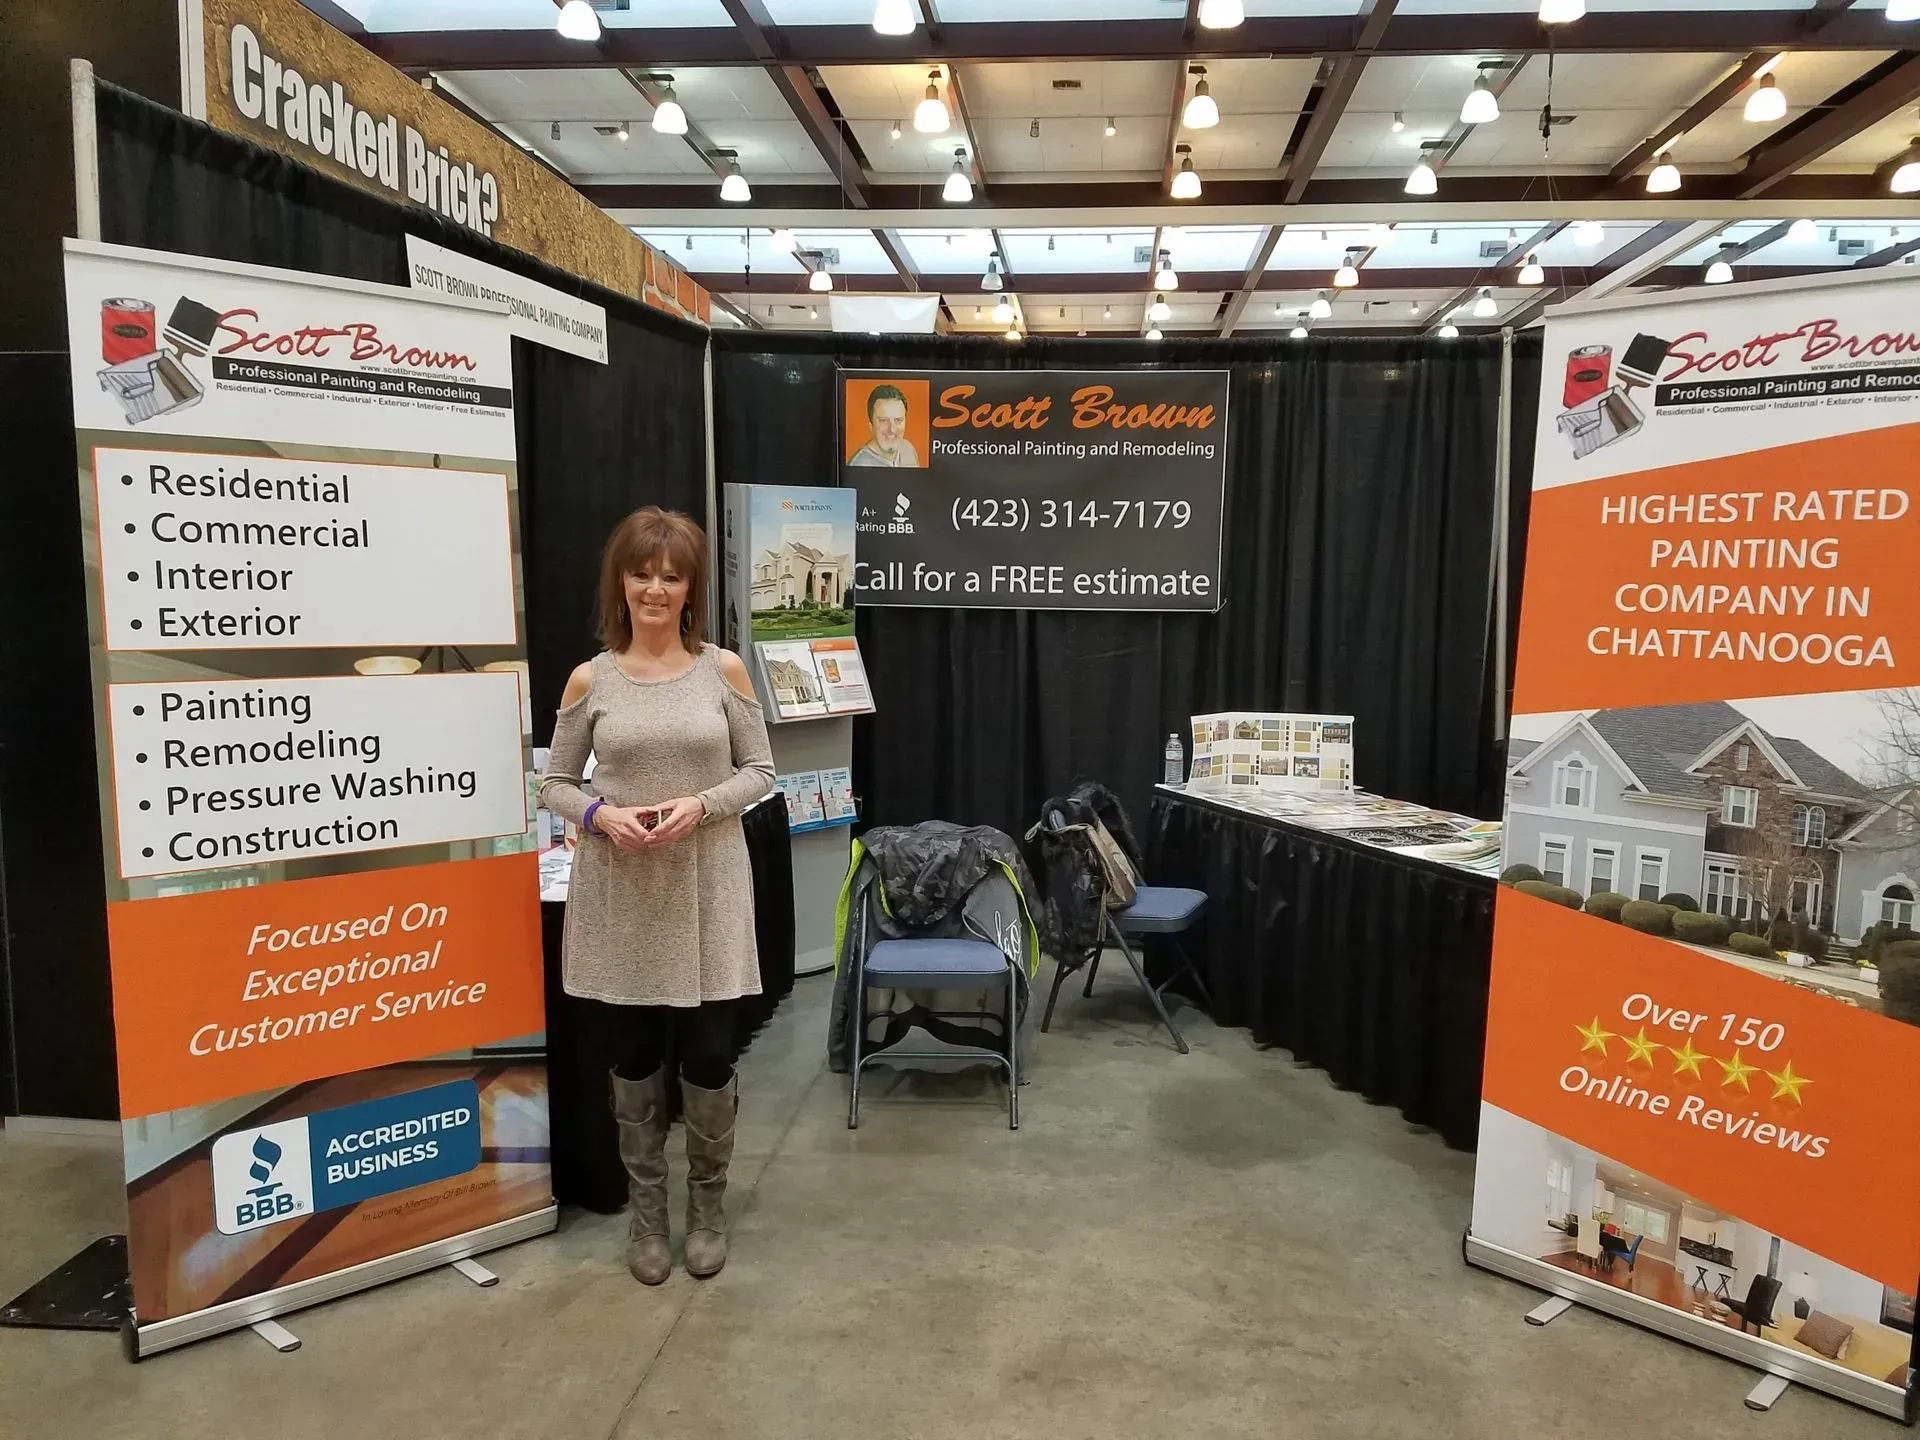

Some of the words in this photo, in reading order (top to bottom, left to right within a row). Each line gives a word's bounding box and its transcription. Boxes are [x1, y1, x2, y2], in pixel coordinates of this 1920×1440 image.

[230, 23, 399, 191] Cracked
[405, 125, 499, 238] Brick?
[415, 264, 443, 291] SCOTT
[447, 275, 479, 299] BROWN
[540, 307, 570, 333] PAINTING
[572, 319, 603, 344] COMPANY
[216, 308, 351, 357] Scott
[343, 323, 477, 371] Brown
[1663, 332, 1806, 382] Scott
[229, 363, 317, 384] Professional
[321, 373, 376, 392] Painting
[380, 380, 404, 394] and
[408, 381, 481, 404] Remodeling
[360, 365, 477, 383] www.scottbrownpainting.com
[1670, 380, 1761, 400] Professional
[1765, 376, 1826, 394] Painting
[1831, 374, 1860, 390] and
[216, 382, 267, 394] Residential
[273, 387, 325, 400] Commercial
[331, 393, 372, 404] Industrial
[378, 397, 410, 408] Exterior
[416, 401, 444, 412] Interior
[451, 404, 468, 415] Free
[470, 406, 506, 418] Estimates
[932, 384, 1052, 430] Scott
[1070, 384, 1215, 430] Brown
[1656, 406, 1705, 416] Residential
[1712, 403, 1767, 414] Commercial
[1774, 399, 1818, 409] Industrial
[1826, 396, 1864, 406] Exterior
[1874, 394, 1912, 403] Interior
[932, 440, 1020, 457] Professional
[1024, 441, 1086, 460] Painting
[1089, 441, 1118, 457] and
[1122, 441, 1215, 460] Remodeling
[149, 464, 350, 503] Residential
[861, 506, 877, 517] A+
[951, 497, 1030, 532] (423)
[1040, 500, 1192, 530] 314-7179
[1601, 492, 1764, 524] HIGHEST
[1773, 488, 1910, 522] RATED
[151, 511, 370, 548] Commercial
[887, 523, 914, 534] BBB
[1650, 538, 1839, 569] PAINTING
[155, 560, 293, 590] Interior
[854, 562, 903, 590] Call
[913, 562, 956, 592] for
[964, 570, 980, 592] a
[991, 565, 1064, 594] FREE
[1073, 568, 1210, 597] estimate
[1614, 583, 1815, 616] COMPANY
[1825, 586, 1871, 617] IN
[158, 606, 301, 637] Exterior
[1587, 626, 1896, 667] CHATTANOOGA
[161, 688, 312, 722] Painting
[164, 730, 381, 769] Remodeling
[167, 779, 321, 816] Pressure
[330, 766, 477, 800] Washing
[168, 815, 399, 861] Construction
[247, 906, 393, 956] Focused
[400, 902, 448, 932] On
[241, 940, 443, 1002] Exceptional
[189, 1003, 366, 1056] Customer
[371, 979, 487, 1023] Service
[1621, 993, 1708, 1034] Over
[1718, 1013, 1785, 1051] 150
[1559, 1066, 1671, 1115] Online
[1677, 1095, 1830, 1158] Reviews
[325, 1107, 471, 1158] ACCREDITED
[328, 1141, 439, 1185] BUSINESS
[405, 1195, 441, 1210] Memory
[469, 1179, 497, 1192] Brown
